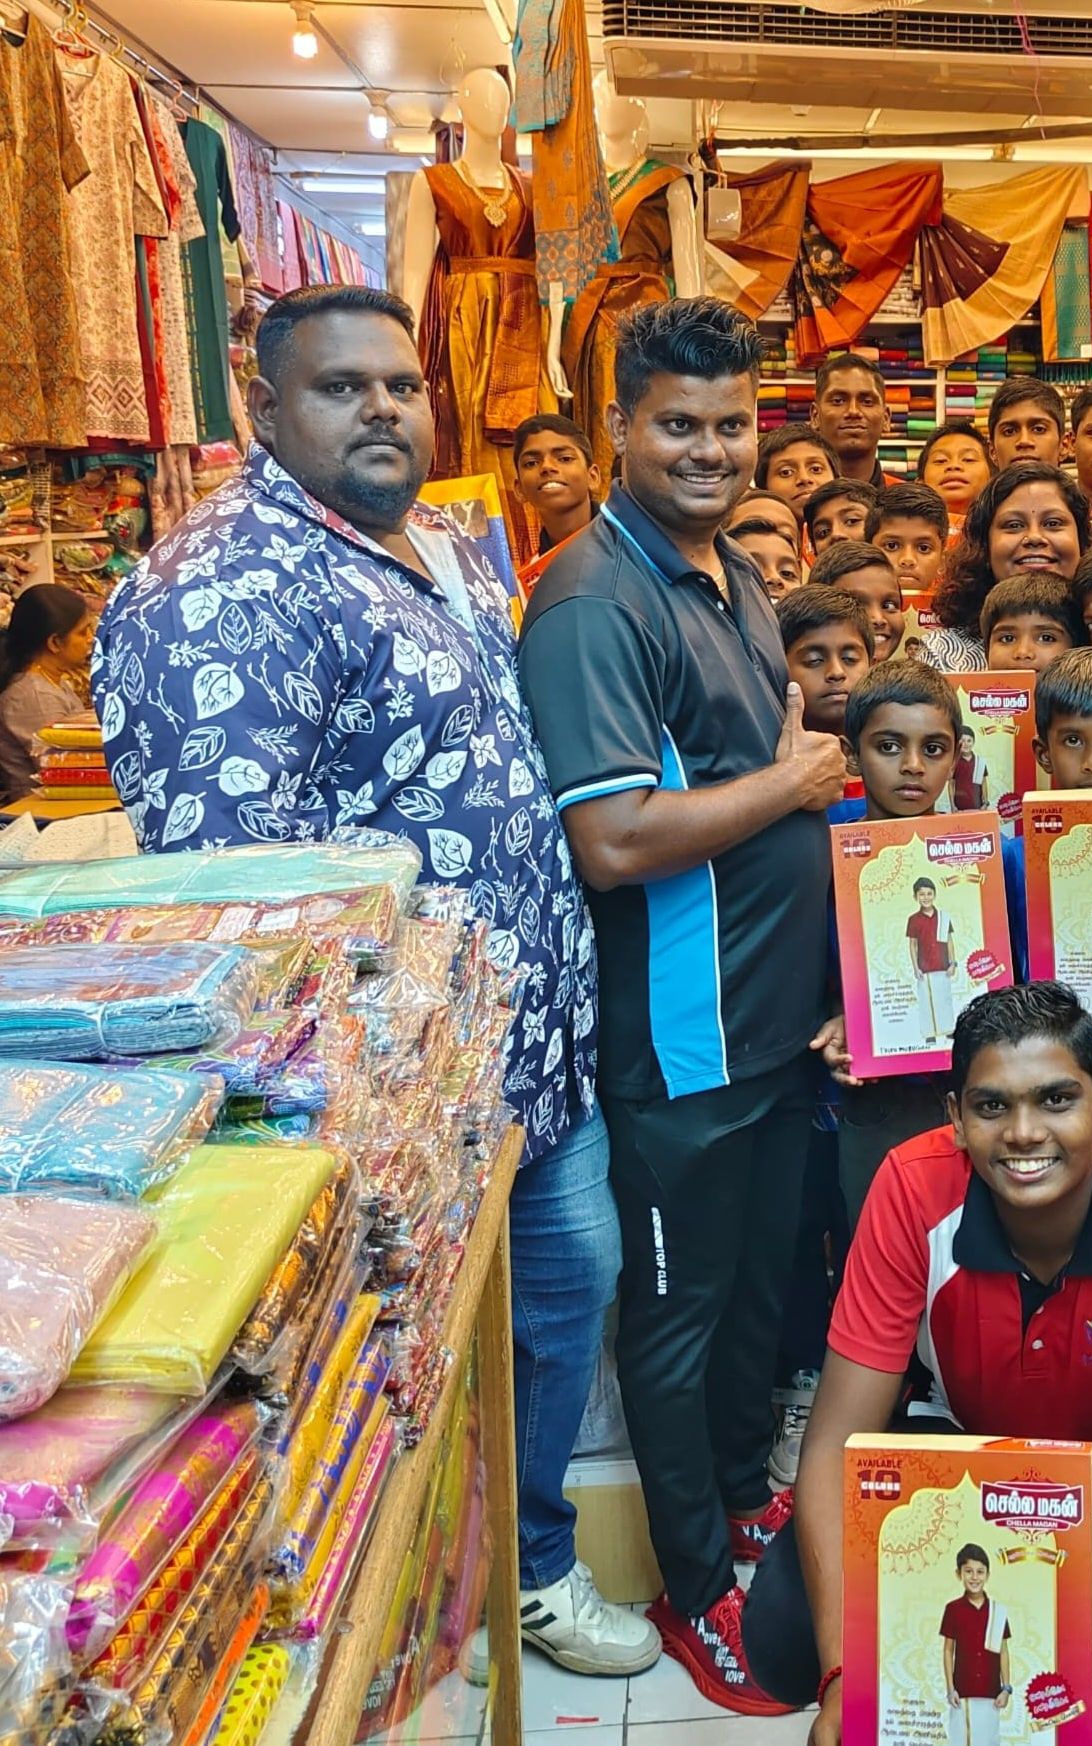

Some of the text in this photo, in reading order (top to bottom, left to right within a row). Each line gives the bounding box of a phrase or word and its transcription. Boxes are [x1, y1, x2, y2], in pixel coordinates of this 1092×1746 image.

[971, 690, 1029, 709] செல்ல மகன்
[839, 830, 870, 840] AVAILABLE
[929, 834, 992, 860] செல்ல மகன்
[655, 1249, 668, 1296] TOP CLUB
[857, 1458, 902, 1468] AVAILABLE
[857, 1469, 901, 1501] 10
[861, 1482, 901, 1492] COLORS
[985, 1489, 1079, 1518] செல்ல மகன்
[1006, 1519, 1058, 1529] CHELLA MAGAN
[725, 1669, 746, 1684] love
